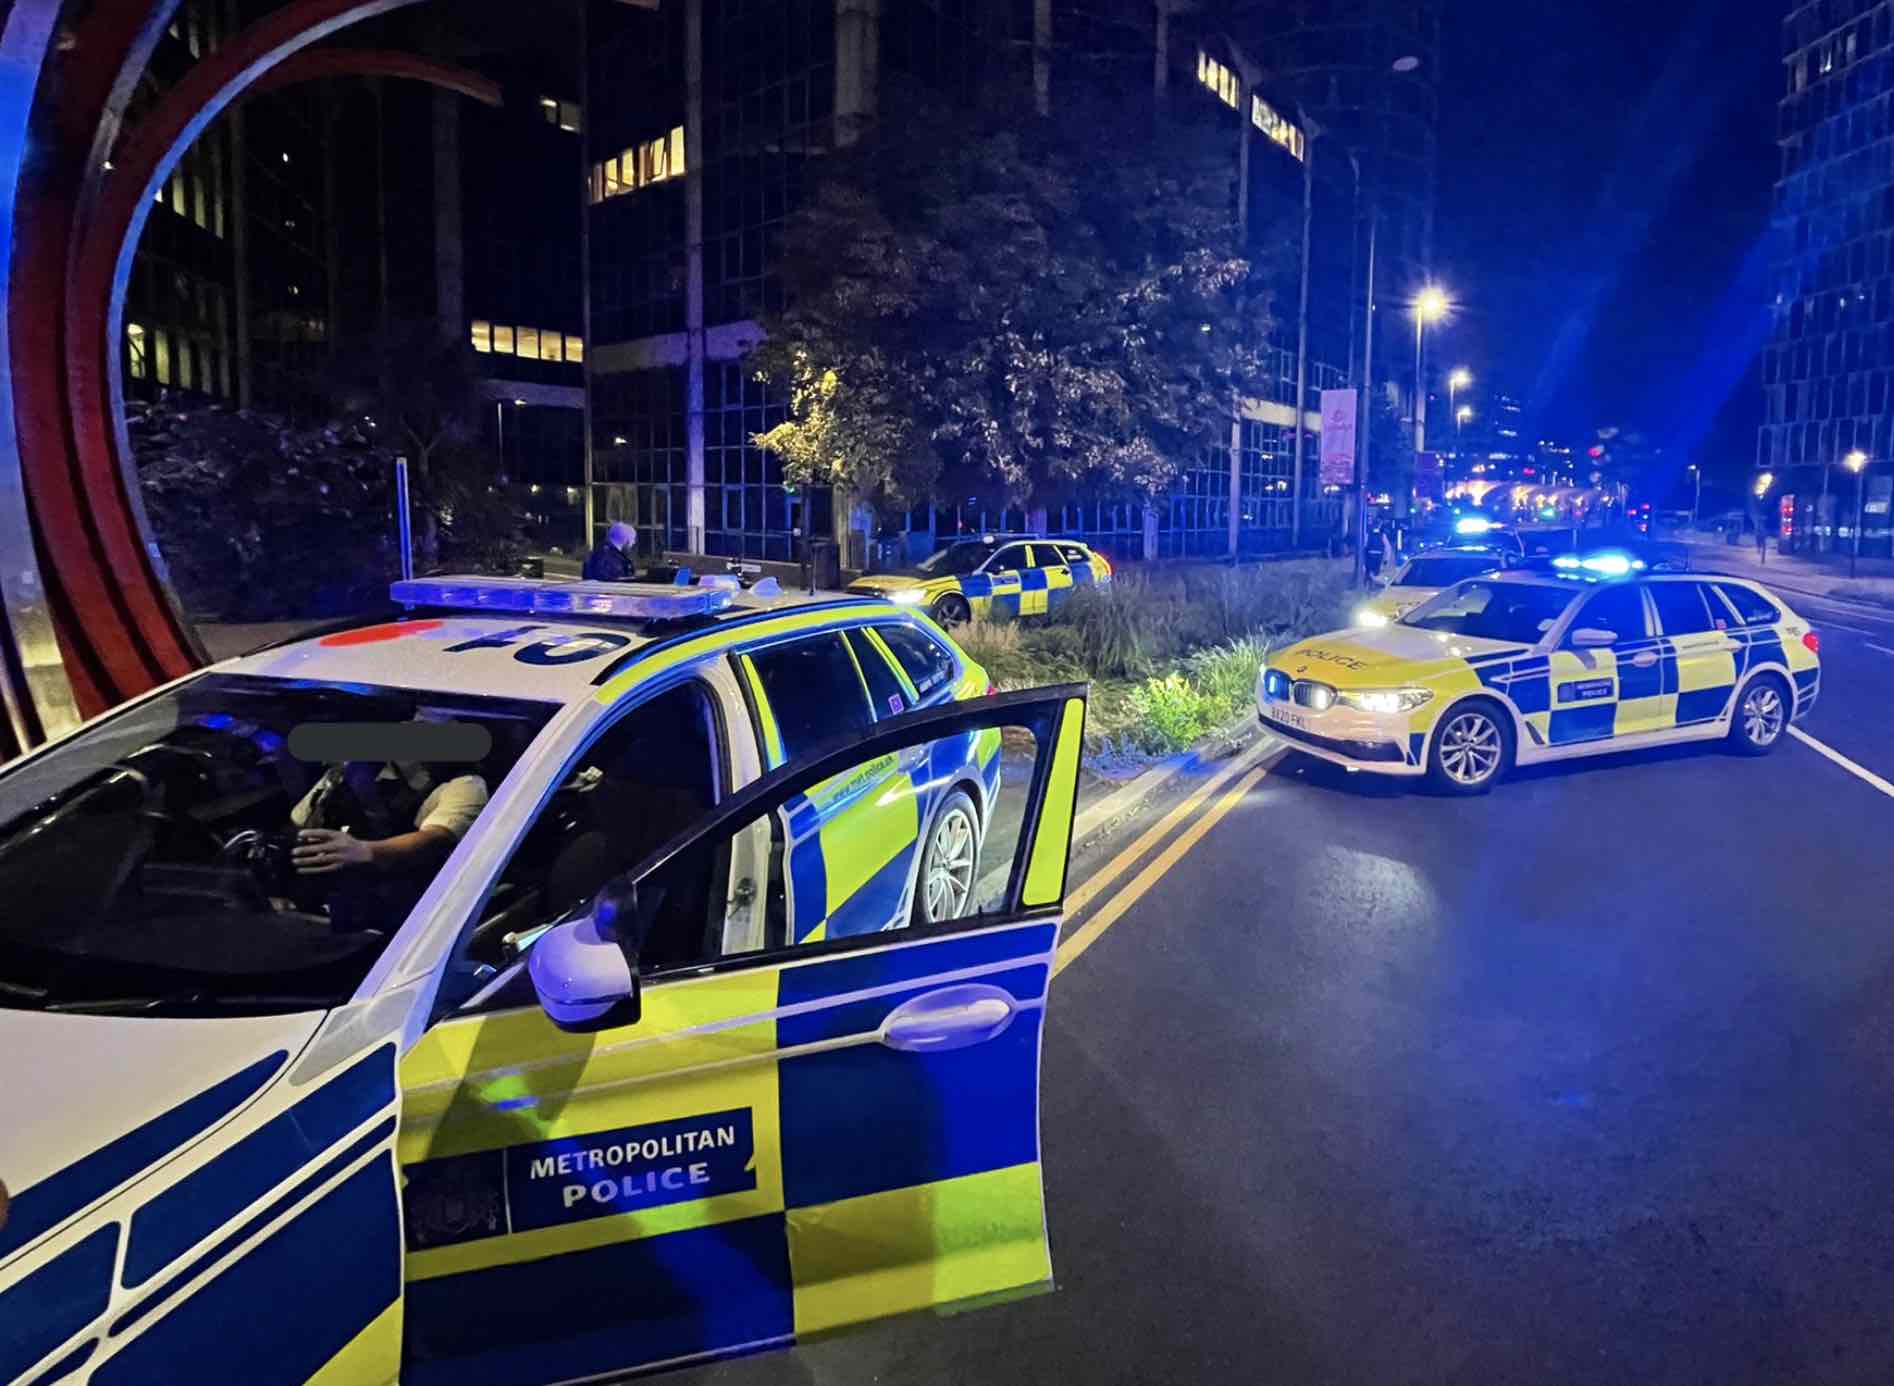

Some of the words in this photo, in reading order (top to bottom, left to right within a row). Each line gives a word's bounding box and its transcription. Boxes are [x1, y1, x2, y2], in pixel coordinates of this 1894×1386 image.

[1295, 648, 1367, 671] POLICE
[530, 1125, 735, 1179] METROPOLITAN
[562, 1162, 710, 1208] POLICE
